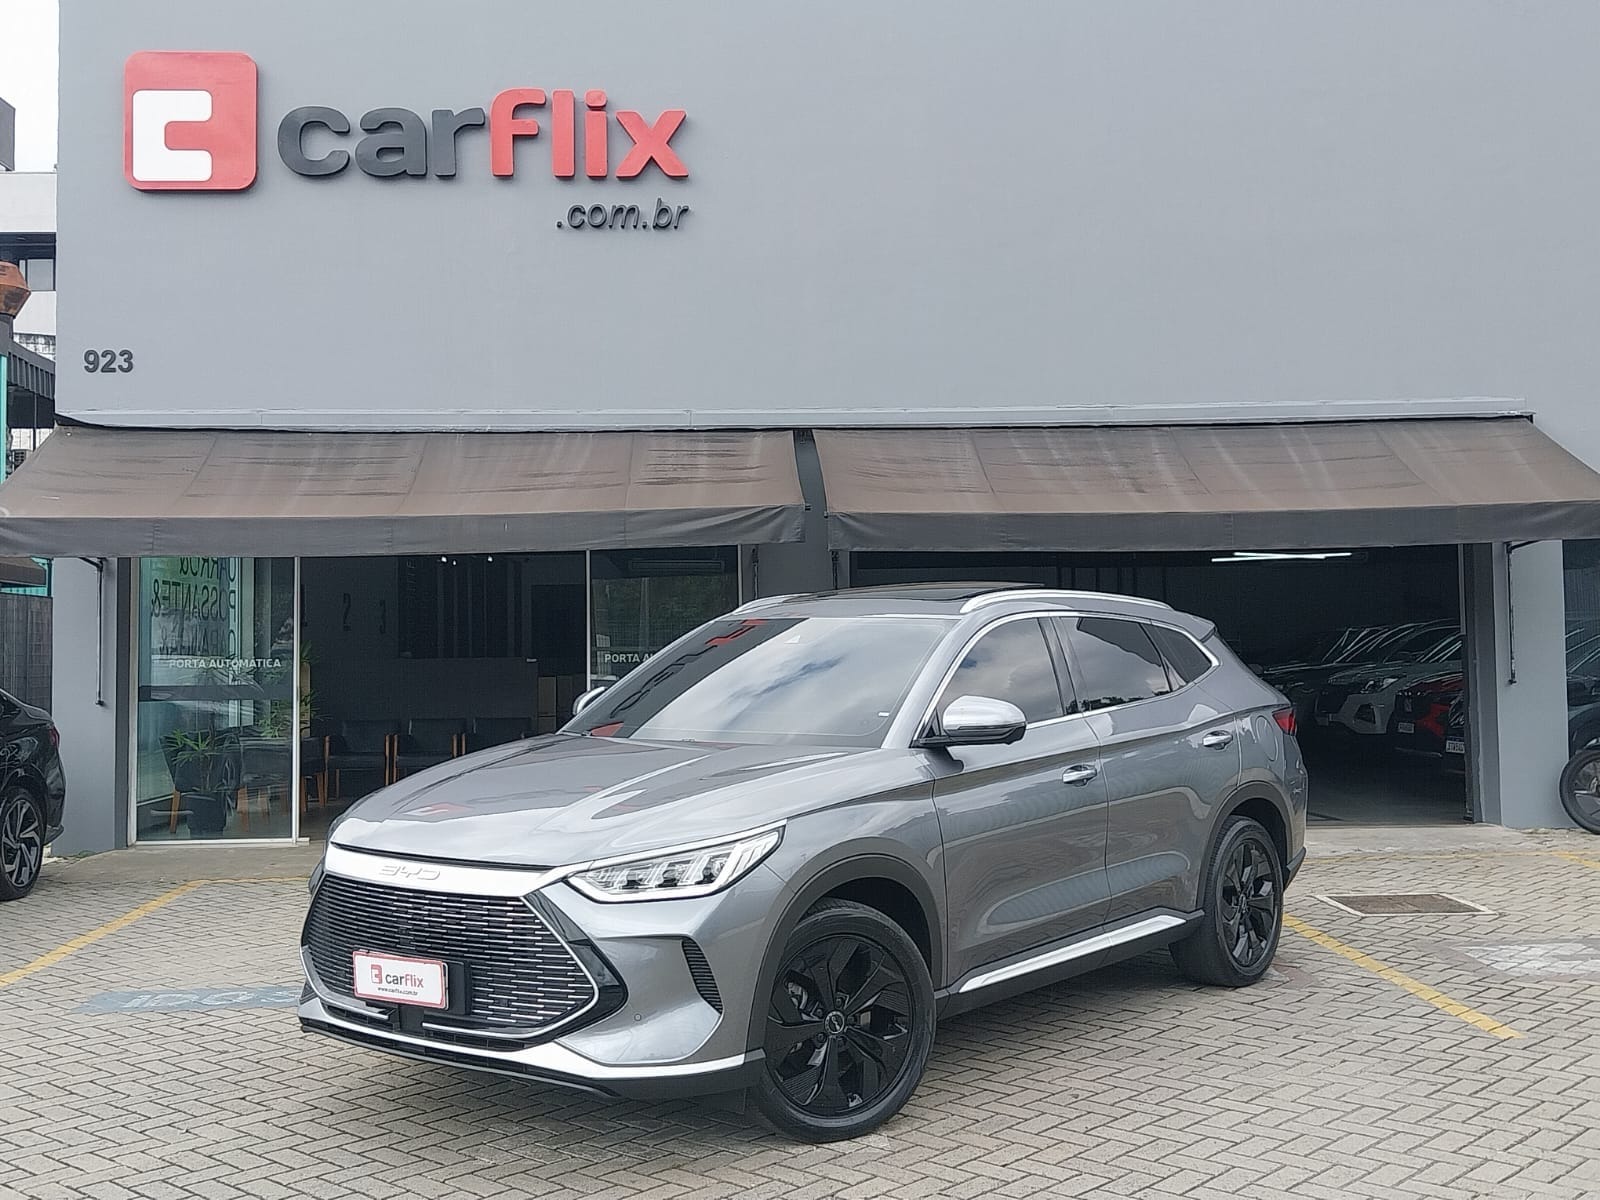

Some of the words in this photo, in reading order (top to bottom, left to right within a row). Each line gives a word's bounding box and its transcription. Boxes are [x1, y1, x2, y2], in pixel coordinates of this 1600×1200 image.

[277, 87, 690, 182] carflix
[556, 198, 692, 231] .com.br
[83, 349, 134, 374] 923
[168, 658, 206, 668] PORTA
[604, 653, 639, 663] PORTA
[385, 973, 424, 988] carflix
